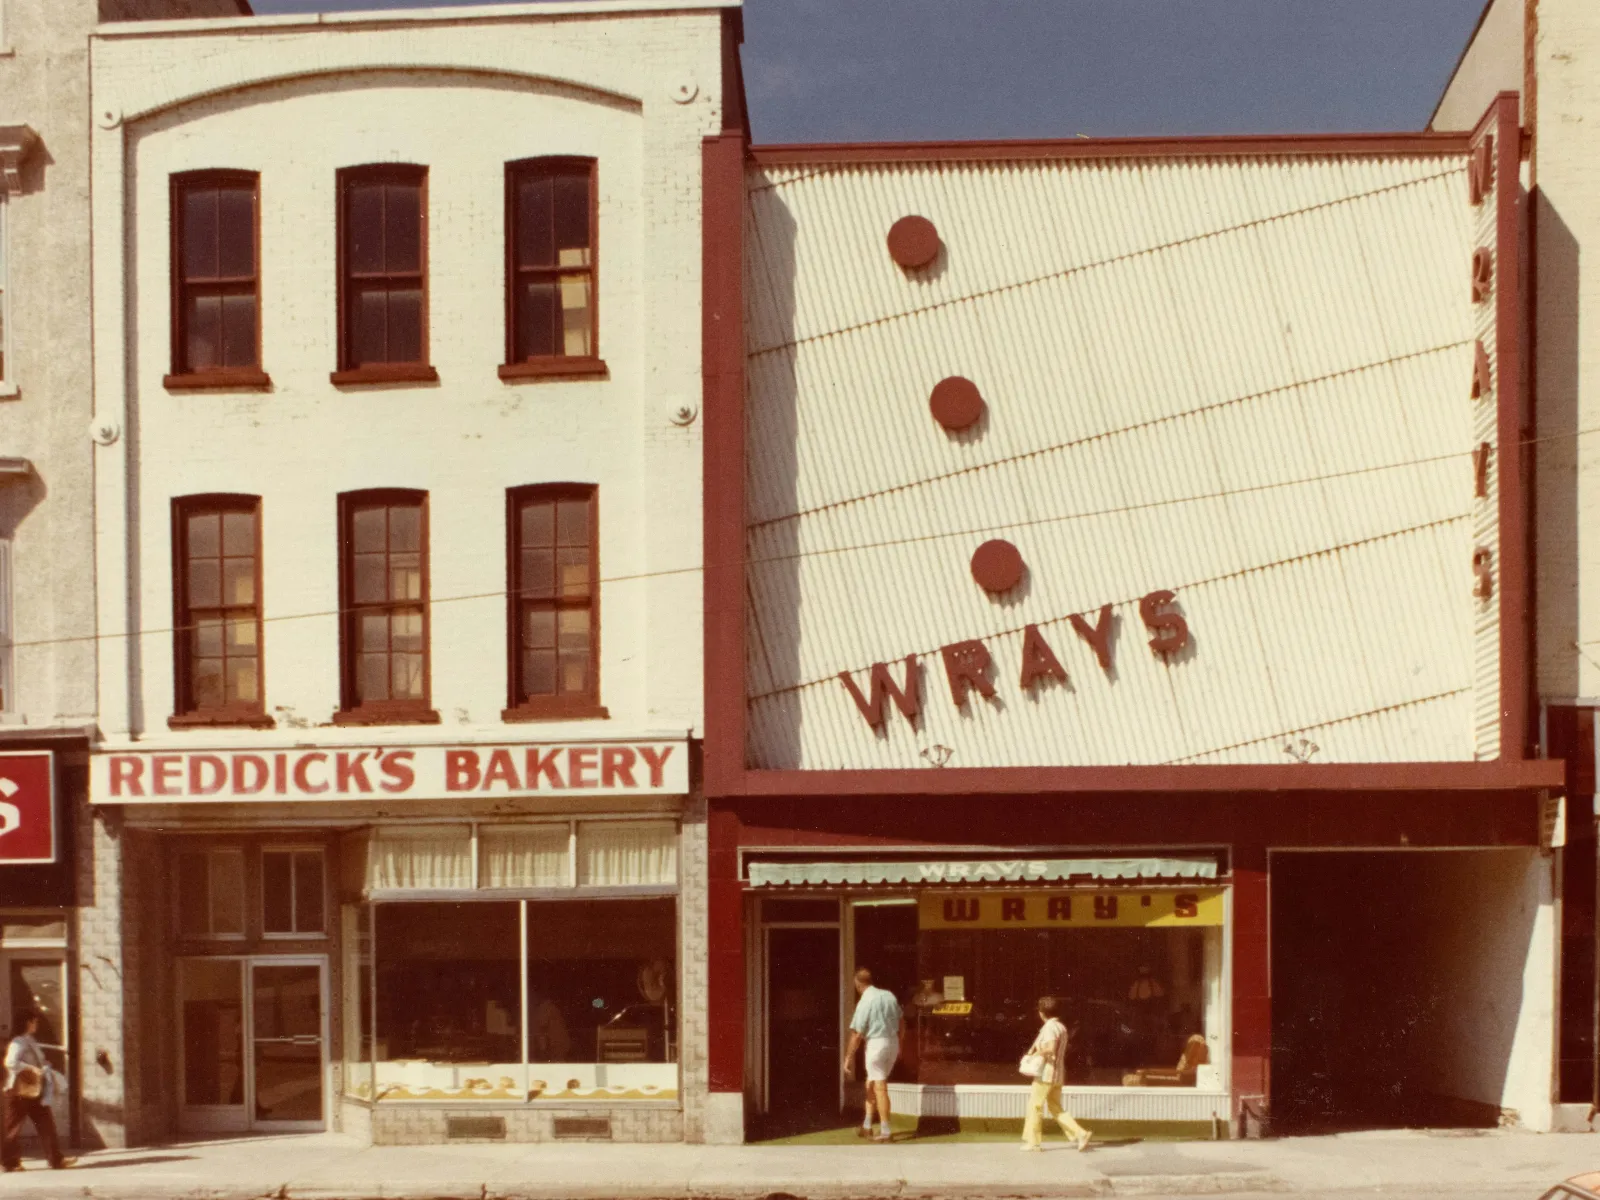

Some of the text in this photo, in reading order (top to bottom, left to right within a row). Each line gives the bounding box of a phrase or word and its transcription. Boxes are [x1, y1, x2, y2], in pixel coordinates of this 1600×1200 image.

[838, 589, 1190, 730] WRAYS
[108, 745, 675, 797] REDDICK'S BAKERY
[918, 860, 1049, 878] WRAY'S
[943, 893, 1198, 922] WRAY'S
